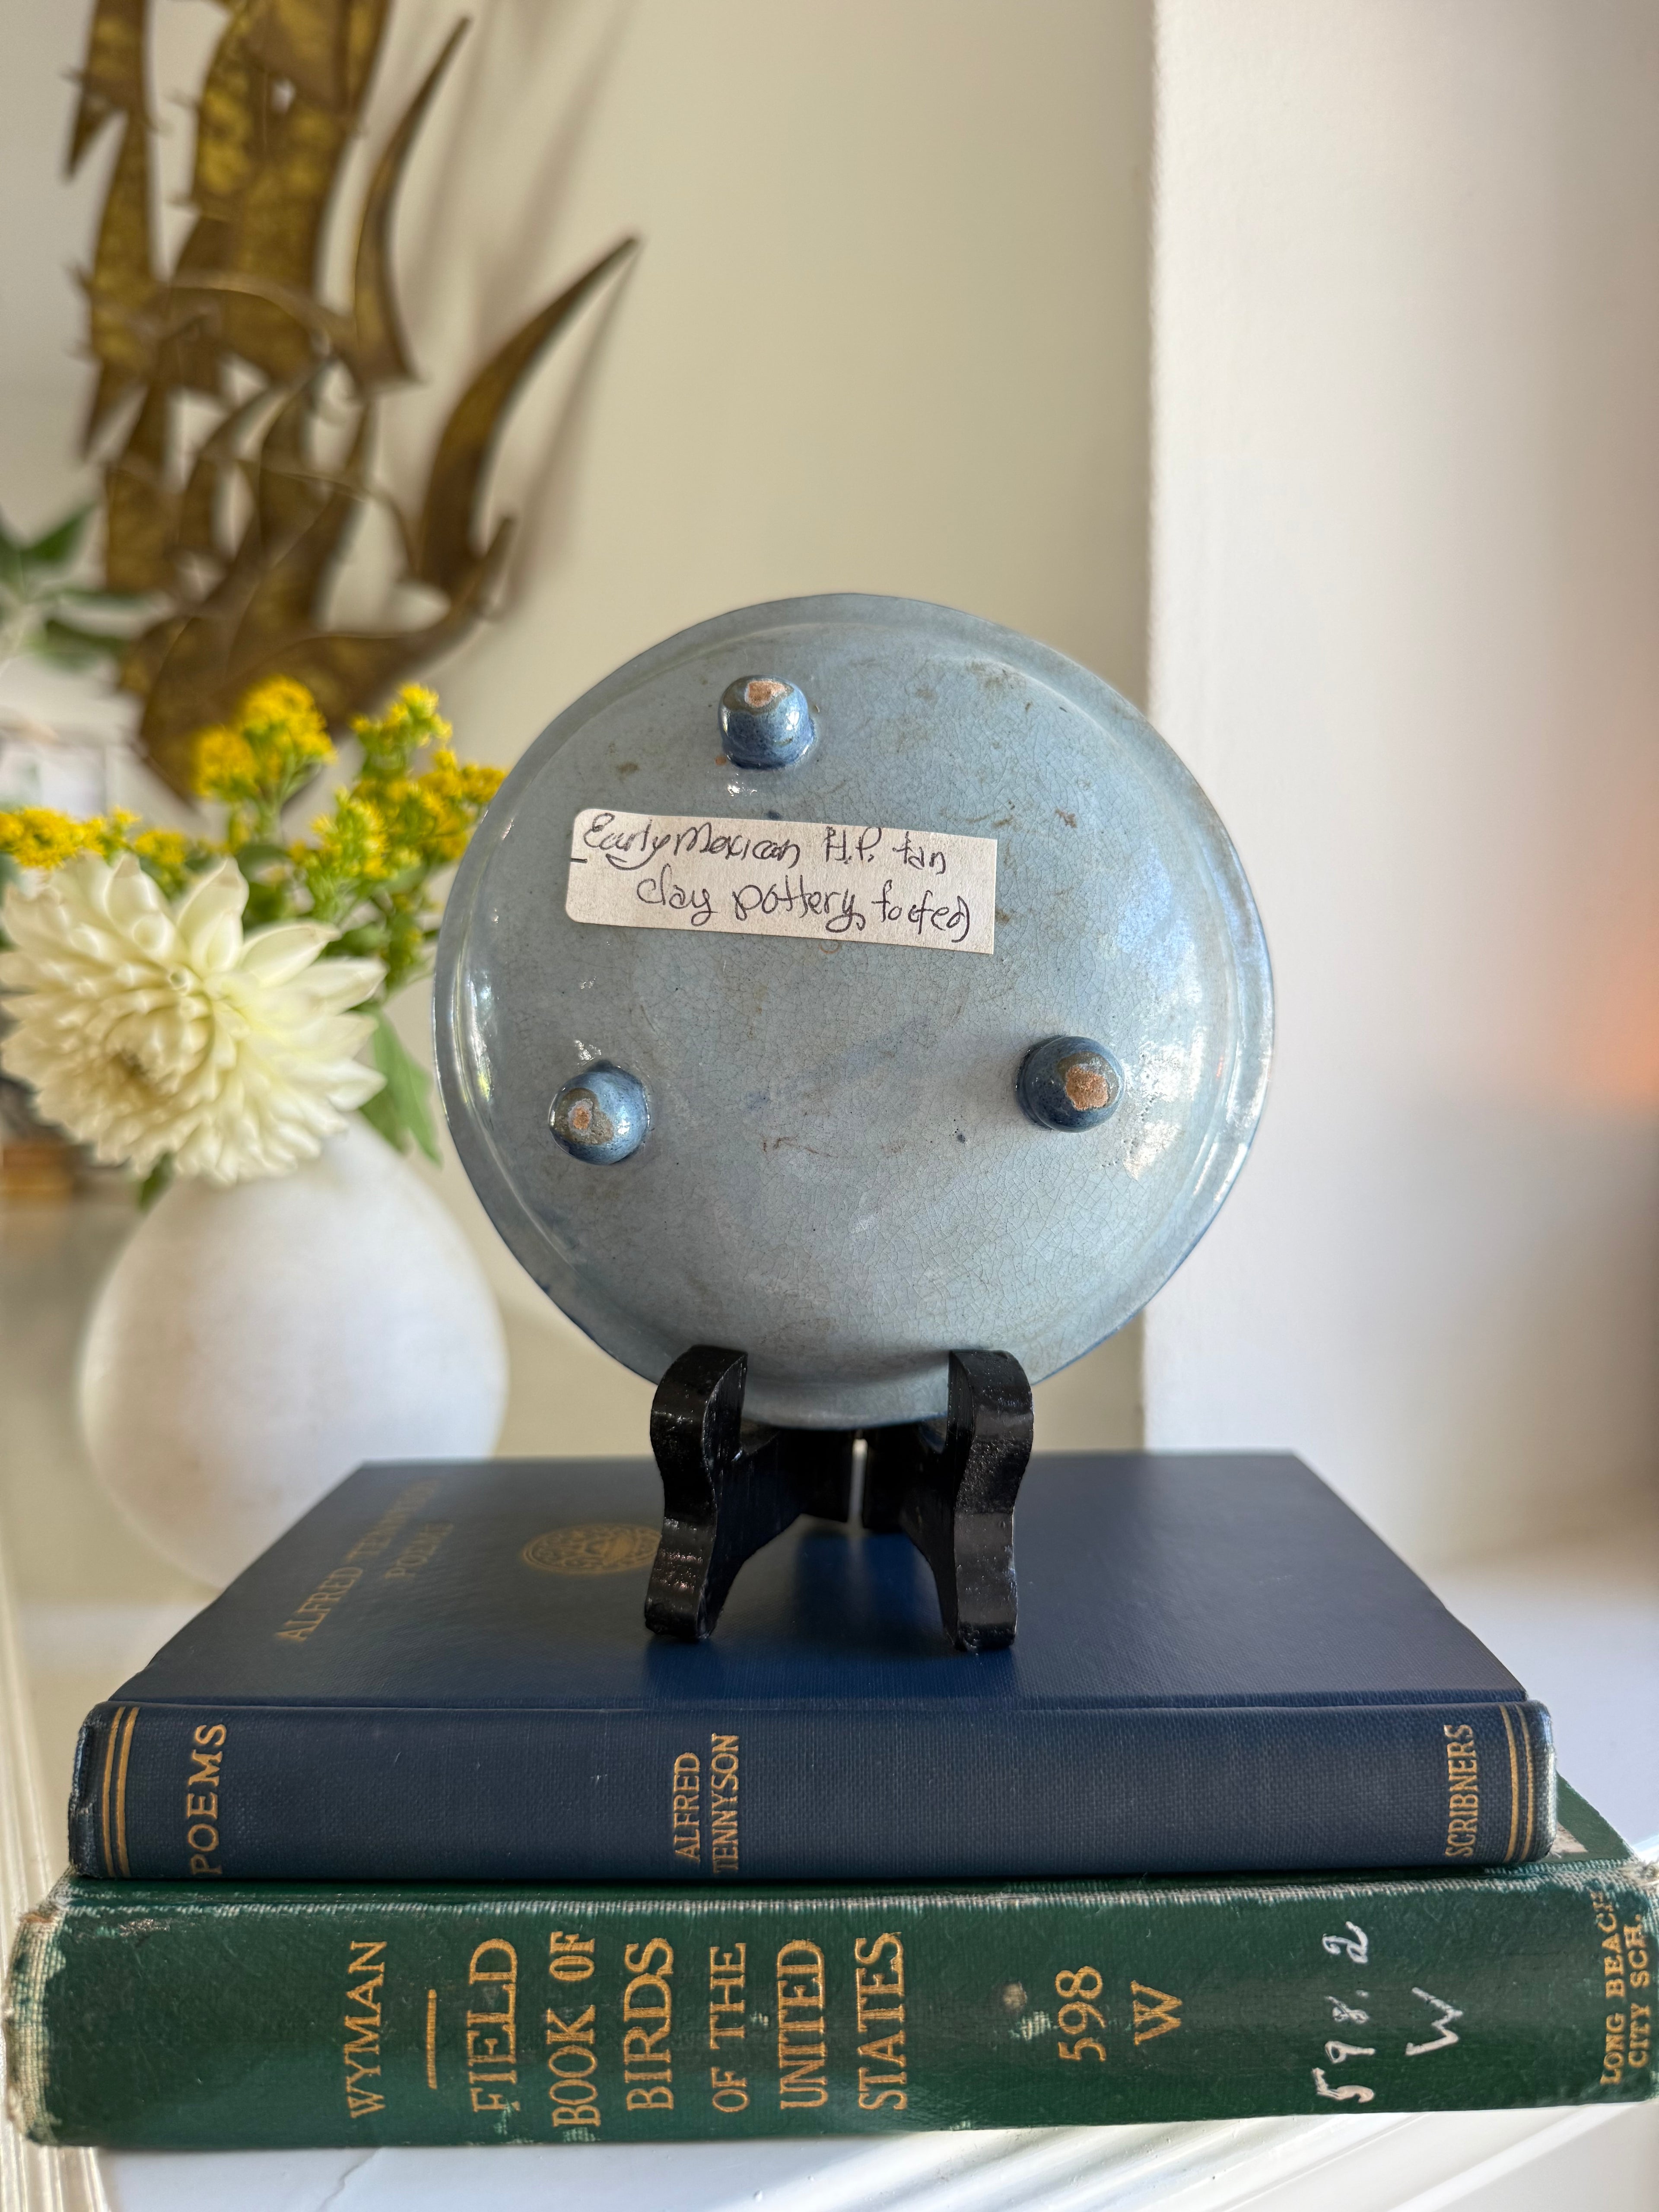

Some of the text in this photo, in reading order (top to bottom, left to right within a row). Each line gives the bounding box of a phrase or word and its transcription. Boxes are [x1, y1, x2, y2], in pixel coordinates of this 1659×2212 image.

[583, 813, 671, 871] Early
[673, 822, 801, 869] Mexican
[892, 830, 947, 875] tan
[636, 863, 718, 927] clay
[274, 1566, 364, 1643] ALFRED
[187, 1723, 227, 1876] POEMS
[673, 1752, 700, 1864] ALFRED
[711, 1732, 739, 1875] TENNYSON
[1443, 1724, 1478, 1858] SCRIBNERS
[343, 1940, 388, 2118] WYMAN
[466, 1938, 521, 2112] FIELD
[546, 1930, 601, 2128] BOOK OF
[623, 1937, 674, 2111] BIRDS
[709, 1942, 750, 2113] OF THE
[777, 1938, 829, 2110] UNITED
[855, 1931, 907, 2110] STATES
[1055, 1965, 1107, 2062] 598
[1130, 1980, 1183, 2046] W
[1405, 1987, 1464, 2056] W
[1600, 2012, 1626, 2085] LONG
[1623, 1913, 1652, 2069] CITY SCH.
